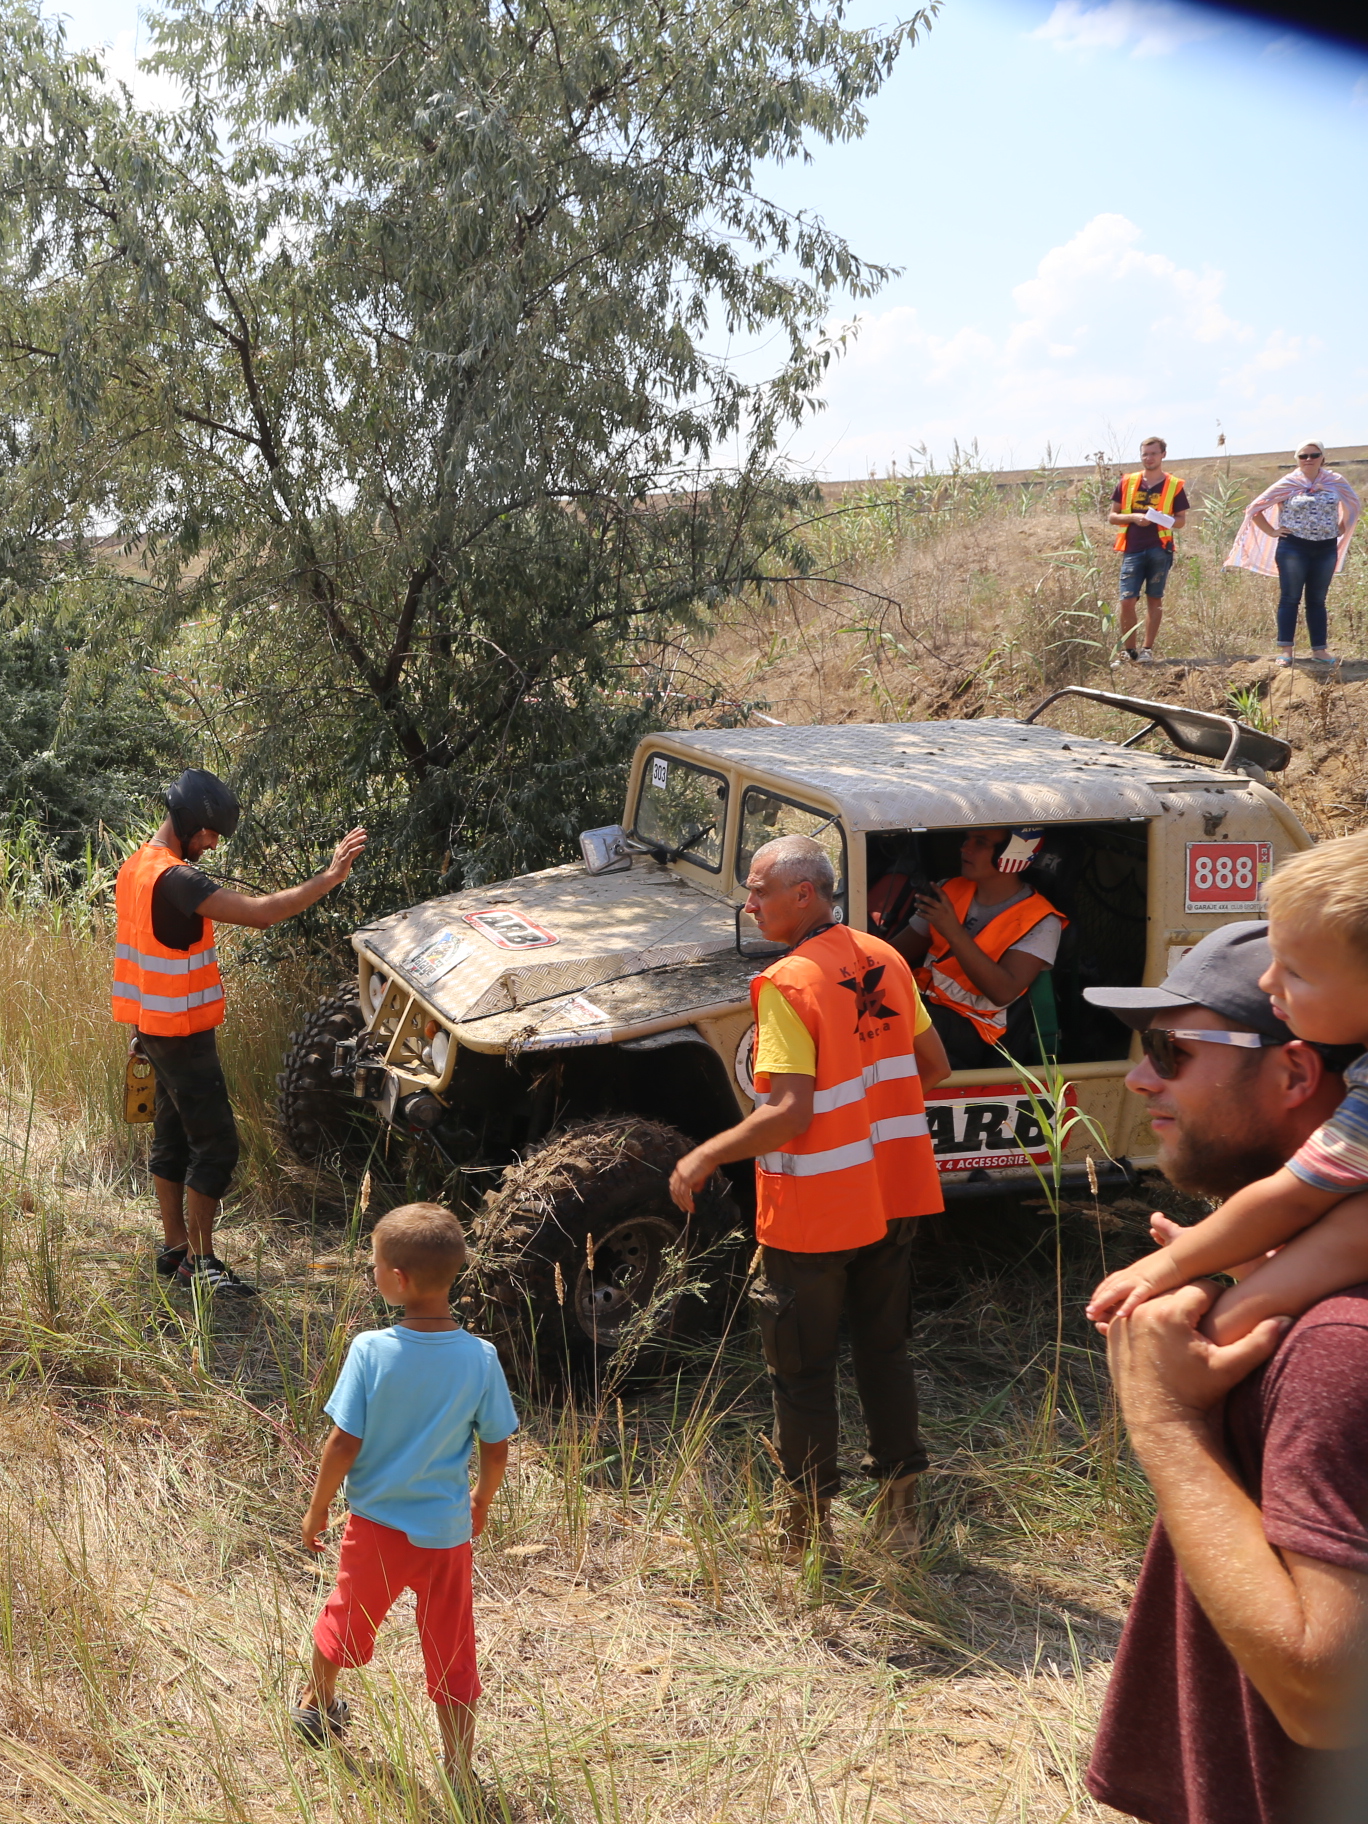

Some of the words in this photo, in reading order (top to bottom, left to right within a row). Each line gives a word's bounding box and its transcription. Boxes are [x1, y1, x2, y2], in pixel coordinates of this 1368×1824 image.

[654, 763, 667, 783] 303
[1194, 856, 1254, 889] 888
[476, 915, 542, 945] ARB
[926, 1099, 1056, 1154] ARB
[946, 1160, 954, 1170] 4
[957, 1155, 1030, 1169] ACCESSORIES
